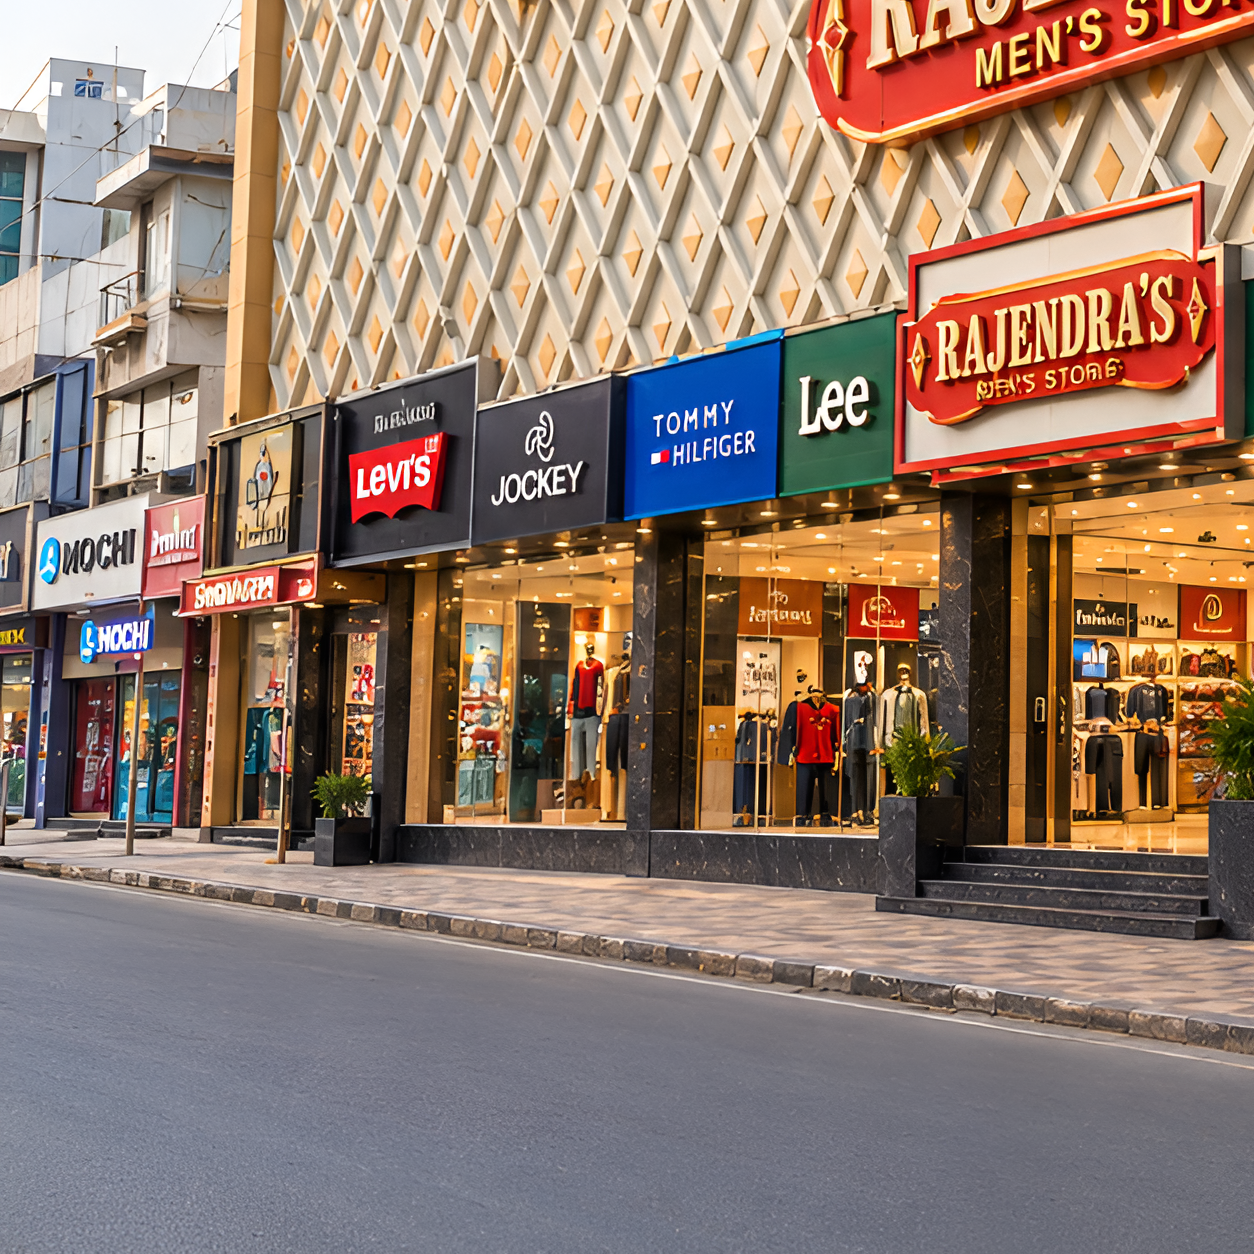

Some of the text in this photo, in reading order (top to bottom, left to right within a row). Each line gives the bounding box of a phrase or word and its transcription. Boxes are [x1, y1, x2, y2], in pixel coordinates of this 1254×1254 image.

[975, 7, 1103, 89] MEN'S
[935, 272, 1175, 382] RAJENDRA'S
[653, 399, 734, 438] TOMMY
[799, 375, 870, 436] Lee
[672, 430, 756, 467] HILFIGER
[491, 460, 584, 507] JOCKEY
